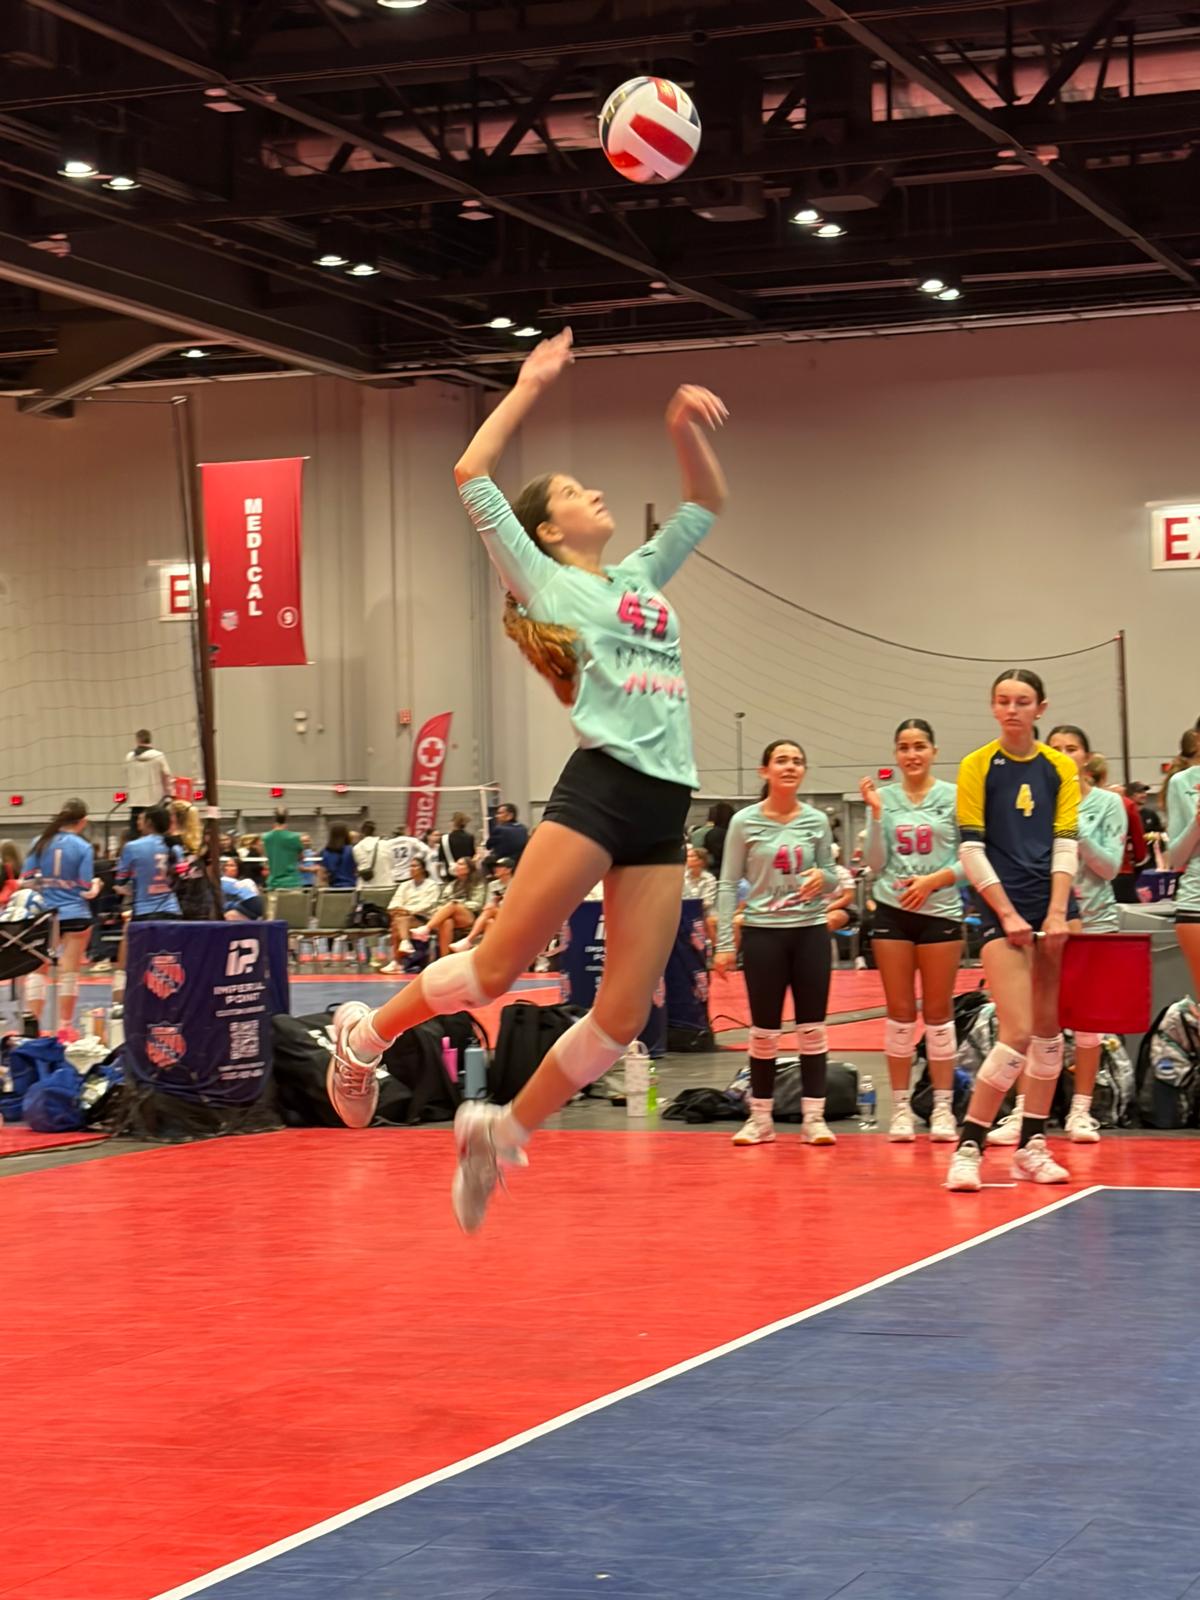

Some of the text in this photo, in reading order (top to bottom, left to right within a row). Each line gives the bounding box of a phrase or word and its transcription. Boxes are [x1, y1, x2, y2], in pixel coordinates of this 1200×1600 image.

[1164, 516, 1200, 561] E
[244, 497, 263, 616] MEDICAL
[1015, 783, 1035, 817] 4
[393, 846, 408, 859] 12
[896, 824, 933, 855] 58
[53, 848, 62, 877] 1
[772, 845, 803, 875] 41
